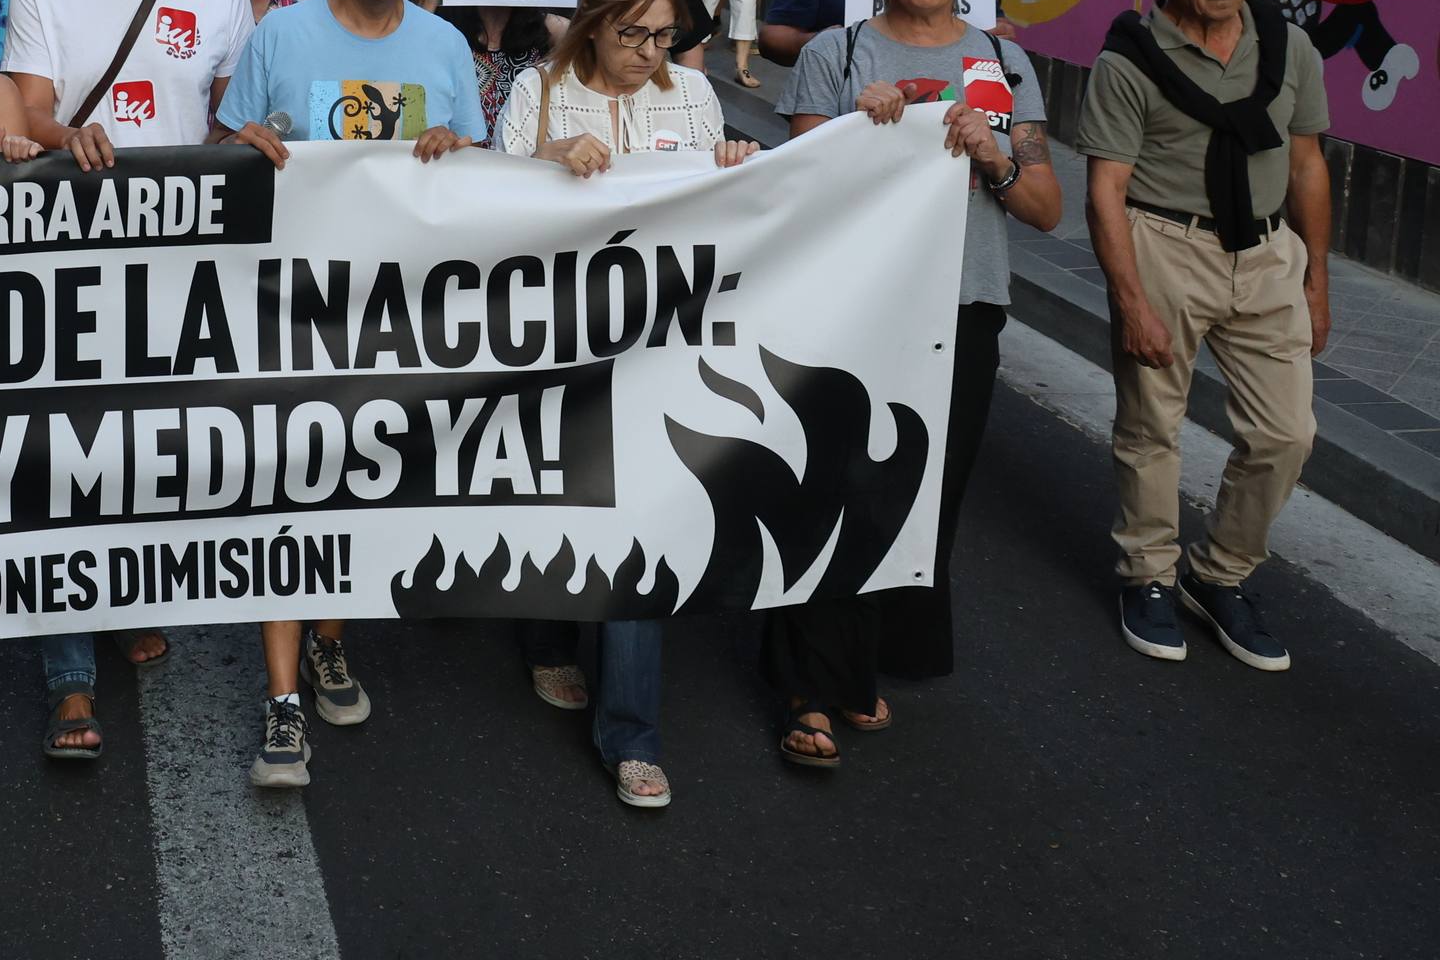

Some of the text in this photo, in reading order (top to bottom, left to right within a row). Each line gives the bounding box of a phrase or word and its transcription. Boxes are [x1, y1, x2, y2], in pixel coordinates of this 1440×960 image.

[973, 109, 1011, 130] GT
[88, 173, 226, 239] ARDE
[125, 259, 240, 378] LA
[258, 228, 743, 372] INACCIÓN:
[48, 397, 410, 519] MEDIOS
[425, 385, 566, 496] YA!
[109, 525, 352, 608] DIMISIÓN!
